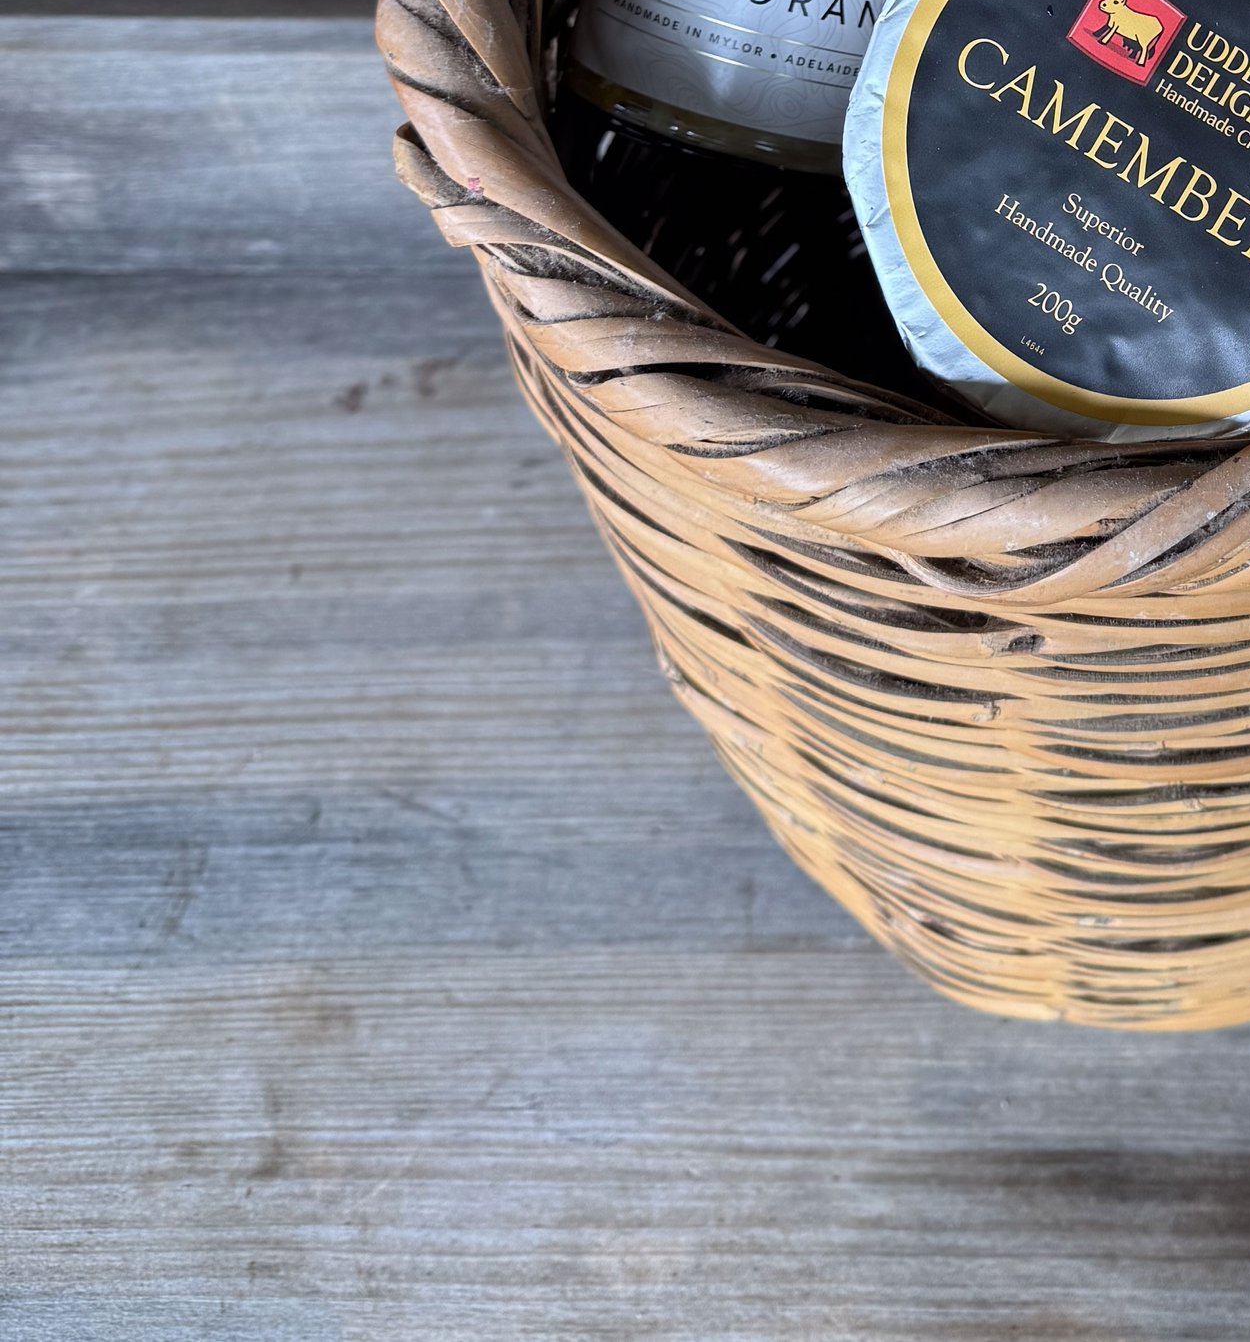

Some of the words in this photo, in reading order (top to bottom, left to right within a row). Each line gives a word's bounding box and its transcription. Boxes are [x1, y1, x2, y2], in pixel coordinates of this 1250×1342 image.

[685, 25, 703, 39] IN
[708, 33, 764, 57] MYLOR
[785, 54, 861, 77] ADELAIDE
[1155, 78, 1236, 137] Handmade
[1062, 193, 1145, 257] Superior
[994, 193, 1098, 273] Handmade
[1099, 263, 1174, 323] Quality
[1027, 282, 1083, 335] 200g
